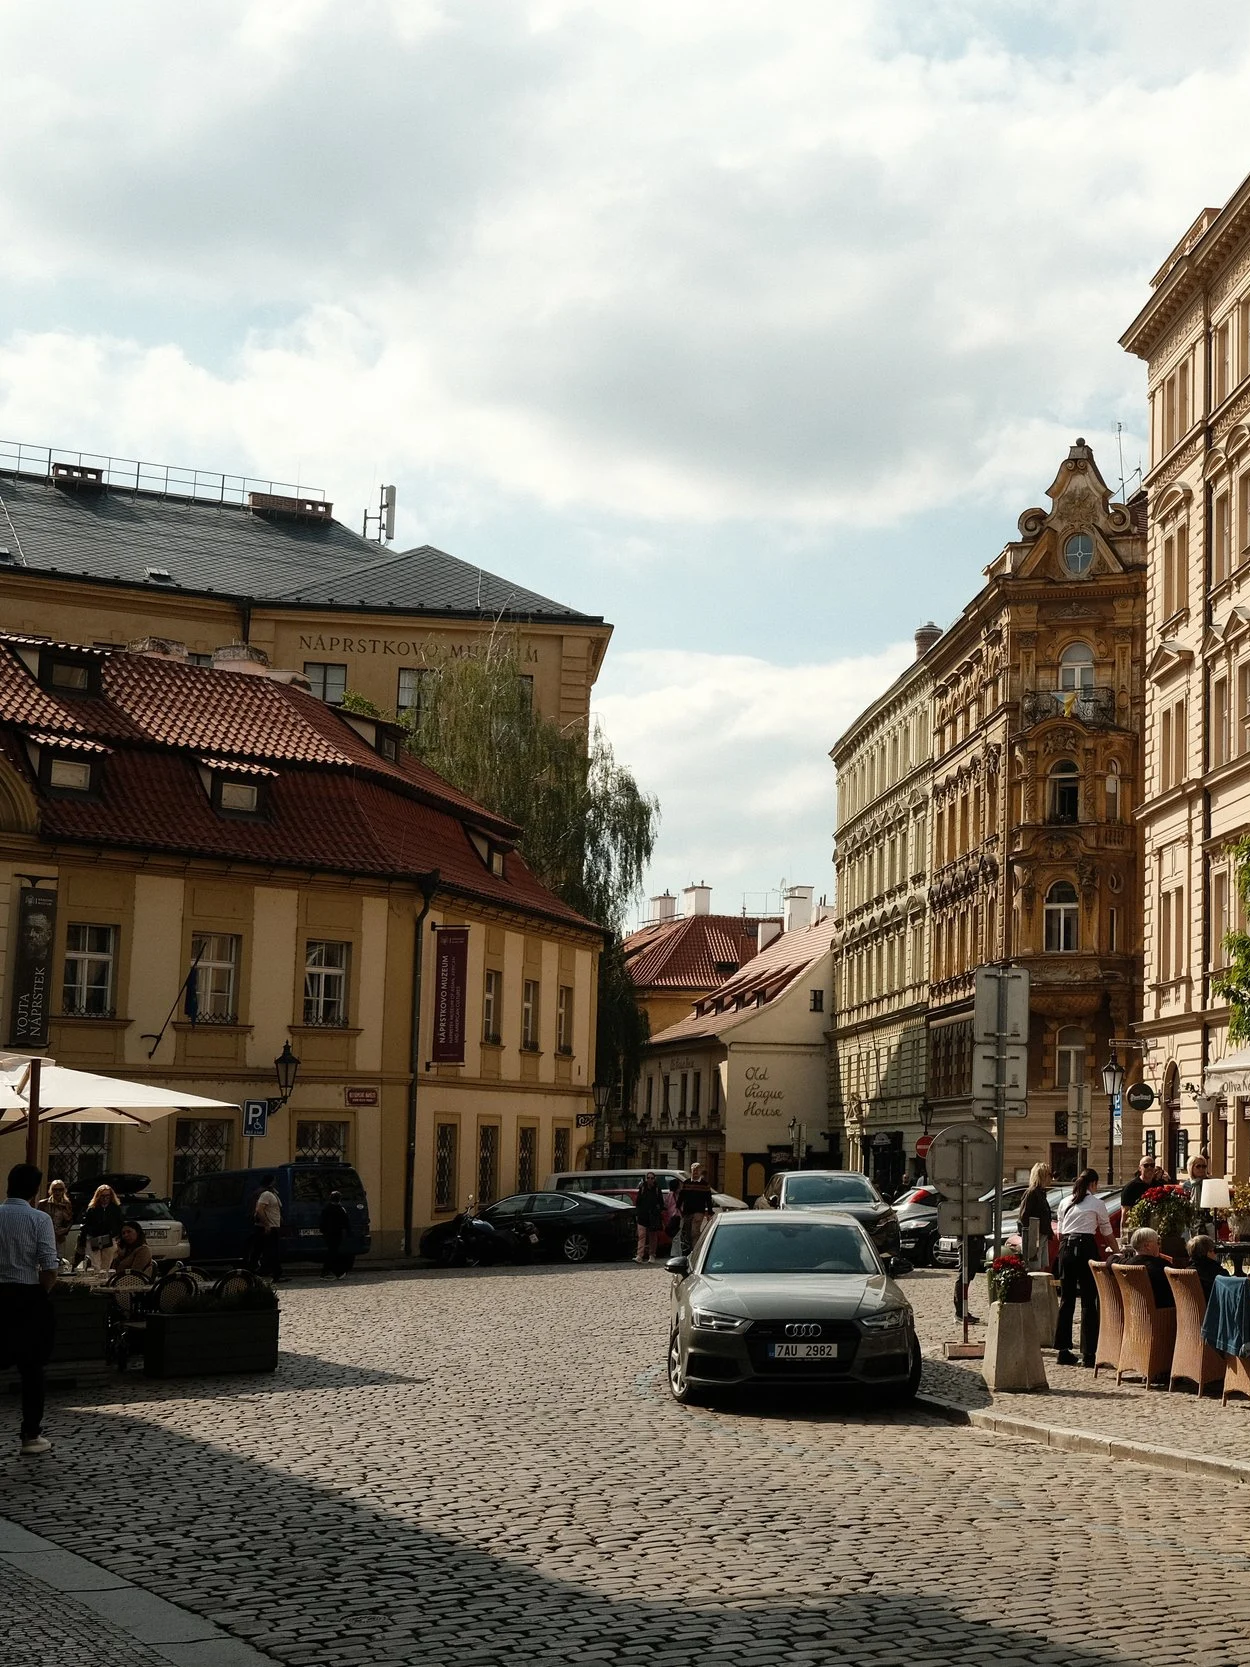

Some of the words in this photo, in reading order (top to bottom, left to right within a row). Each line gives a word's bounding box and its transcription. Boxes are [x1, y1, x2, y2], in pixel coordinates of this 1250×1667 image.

[300, 634, 438, 657] NÁPRSTKOVO
[441, 955, 449, 990] MUZEUM
[28, 967, 46, 1037] NÁPRSTEK
[16, 993, 30, 1036] VOJTA
[438, 990, 448, 1043] NÁPRSTKOVO
[745, 1067, 770, 1080] Old
[745, 1083, 784, 1105] Prague
[1223, 1081, 1241, 1093] Oliva
[248, 1104, 263, 1125] P
[744, 1101, 782, 1116] House
[777, 1345, 798, 1356] 7AU
[805, 1345, 832, 1356] 2982
